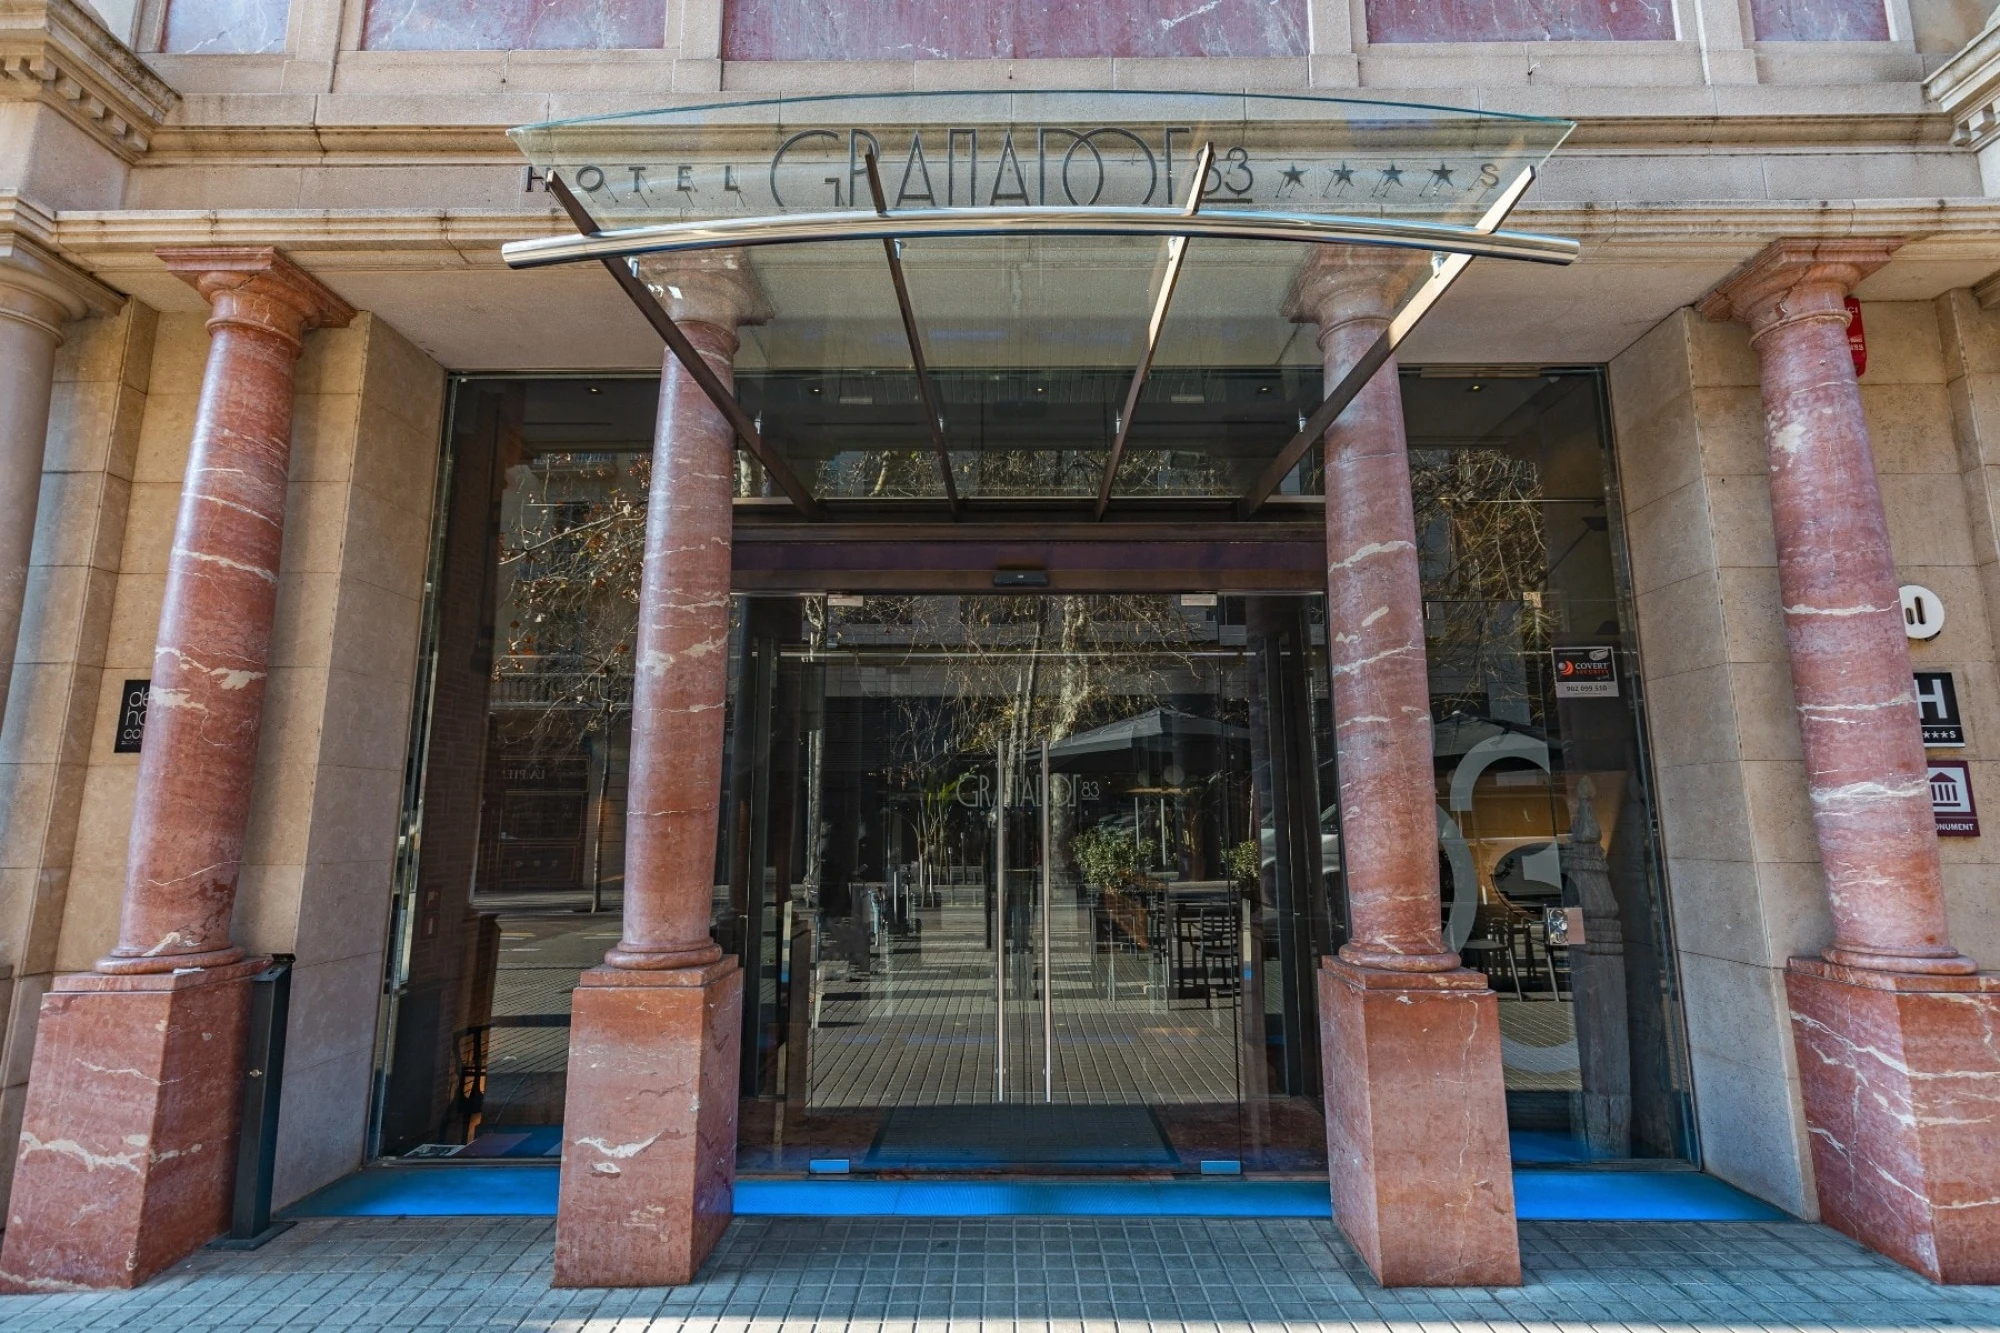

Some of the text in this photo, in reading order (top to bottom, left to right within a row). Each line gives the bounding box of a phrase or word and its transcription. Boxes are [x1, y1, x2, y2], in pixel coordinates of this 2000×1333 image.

[525, 164, 738, 193] HOTEL
[1192, 146, 1254, 195] 83
[1575, 662, 1609, 670] COVERT
[1913, 679, 1948, 719] H
[1081, 781, 1100, 798] 83
[1935, 823, 1974, 831] ONUMENT
